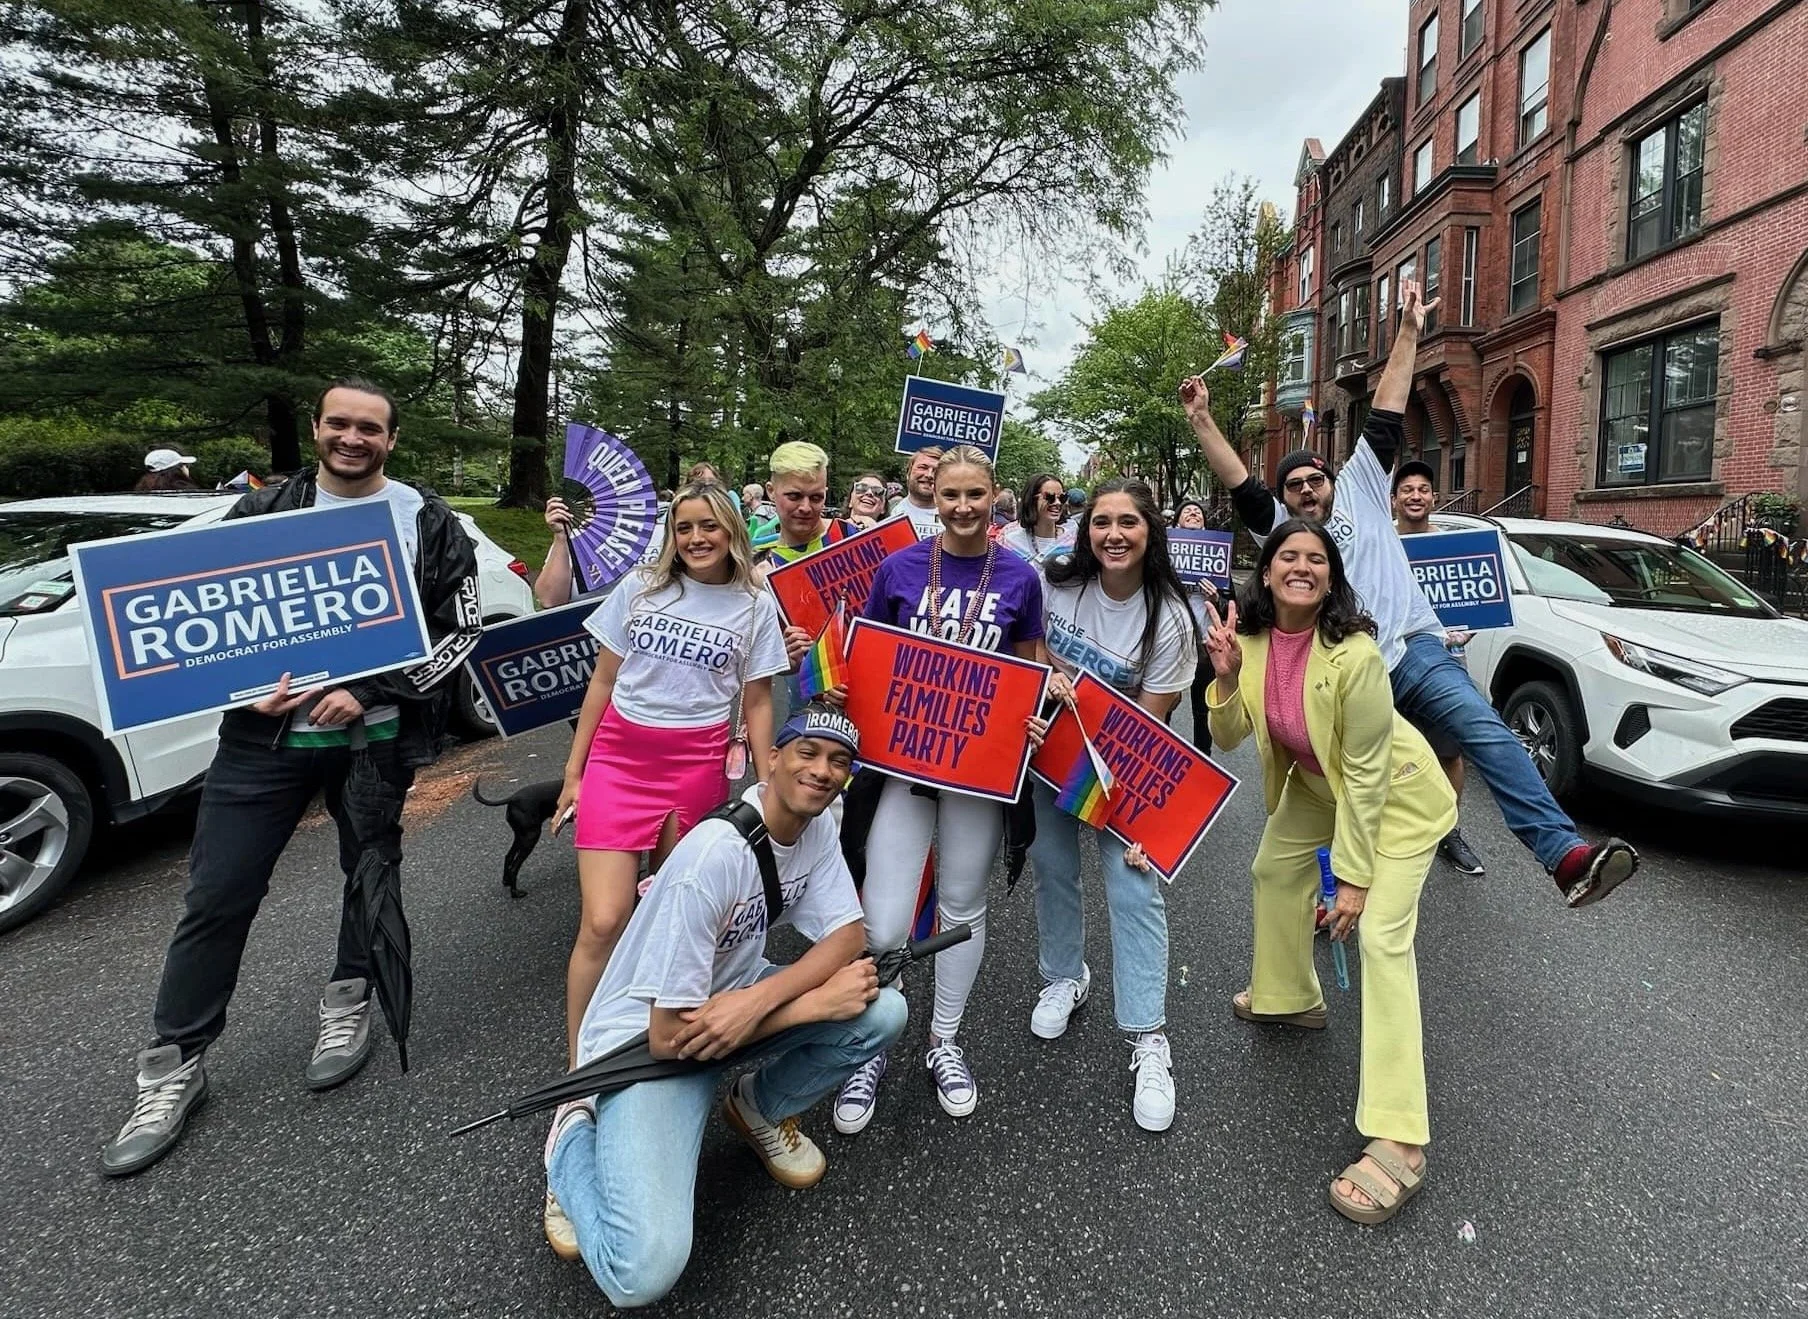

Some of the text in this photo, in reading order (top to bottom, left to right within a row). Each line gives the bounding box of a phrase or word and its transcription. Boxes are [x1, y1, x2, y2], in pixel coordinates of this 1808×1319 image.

[910, 415, 991, 443] ROMERO
[913, 402, 992, 428] GABRIELLA
[588, 442, 644, 497] QUEEN
[804, 536, 889, 591] WORKING
[1168, 542, 1226, 559] BRIELLA
[1170, 554, 1227, 574] MERO
[1412, 560, 1493, 583] BRIELLA
[125, 554, 382, 624] GABRIELLA
[1424, 577, 1497, 603] MERO
[128, 582, 390, 665] ROMERO
[185, 623, 354, 668] DEMOCRAT FOR ASSEMBLY
[408, 575, 479, 686] SPACE XPLORER
[1049, 611, 1085, 639] CHLOE
[629, 628, 730, 670] ROMERO
[892, 642, 1000, 701] WORKING
[1049, 627, 1133, 685] PIERCE
[503, 658, 595, 702] ROM
[810, 712, 859, 744] ROMERO
[884, 679, 991, 737] FAMILIES
[888, 718, 969, 770] PARTY
[1100, 702, 1193, 785] WORKING
